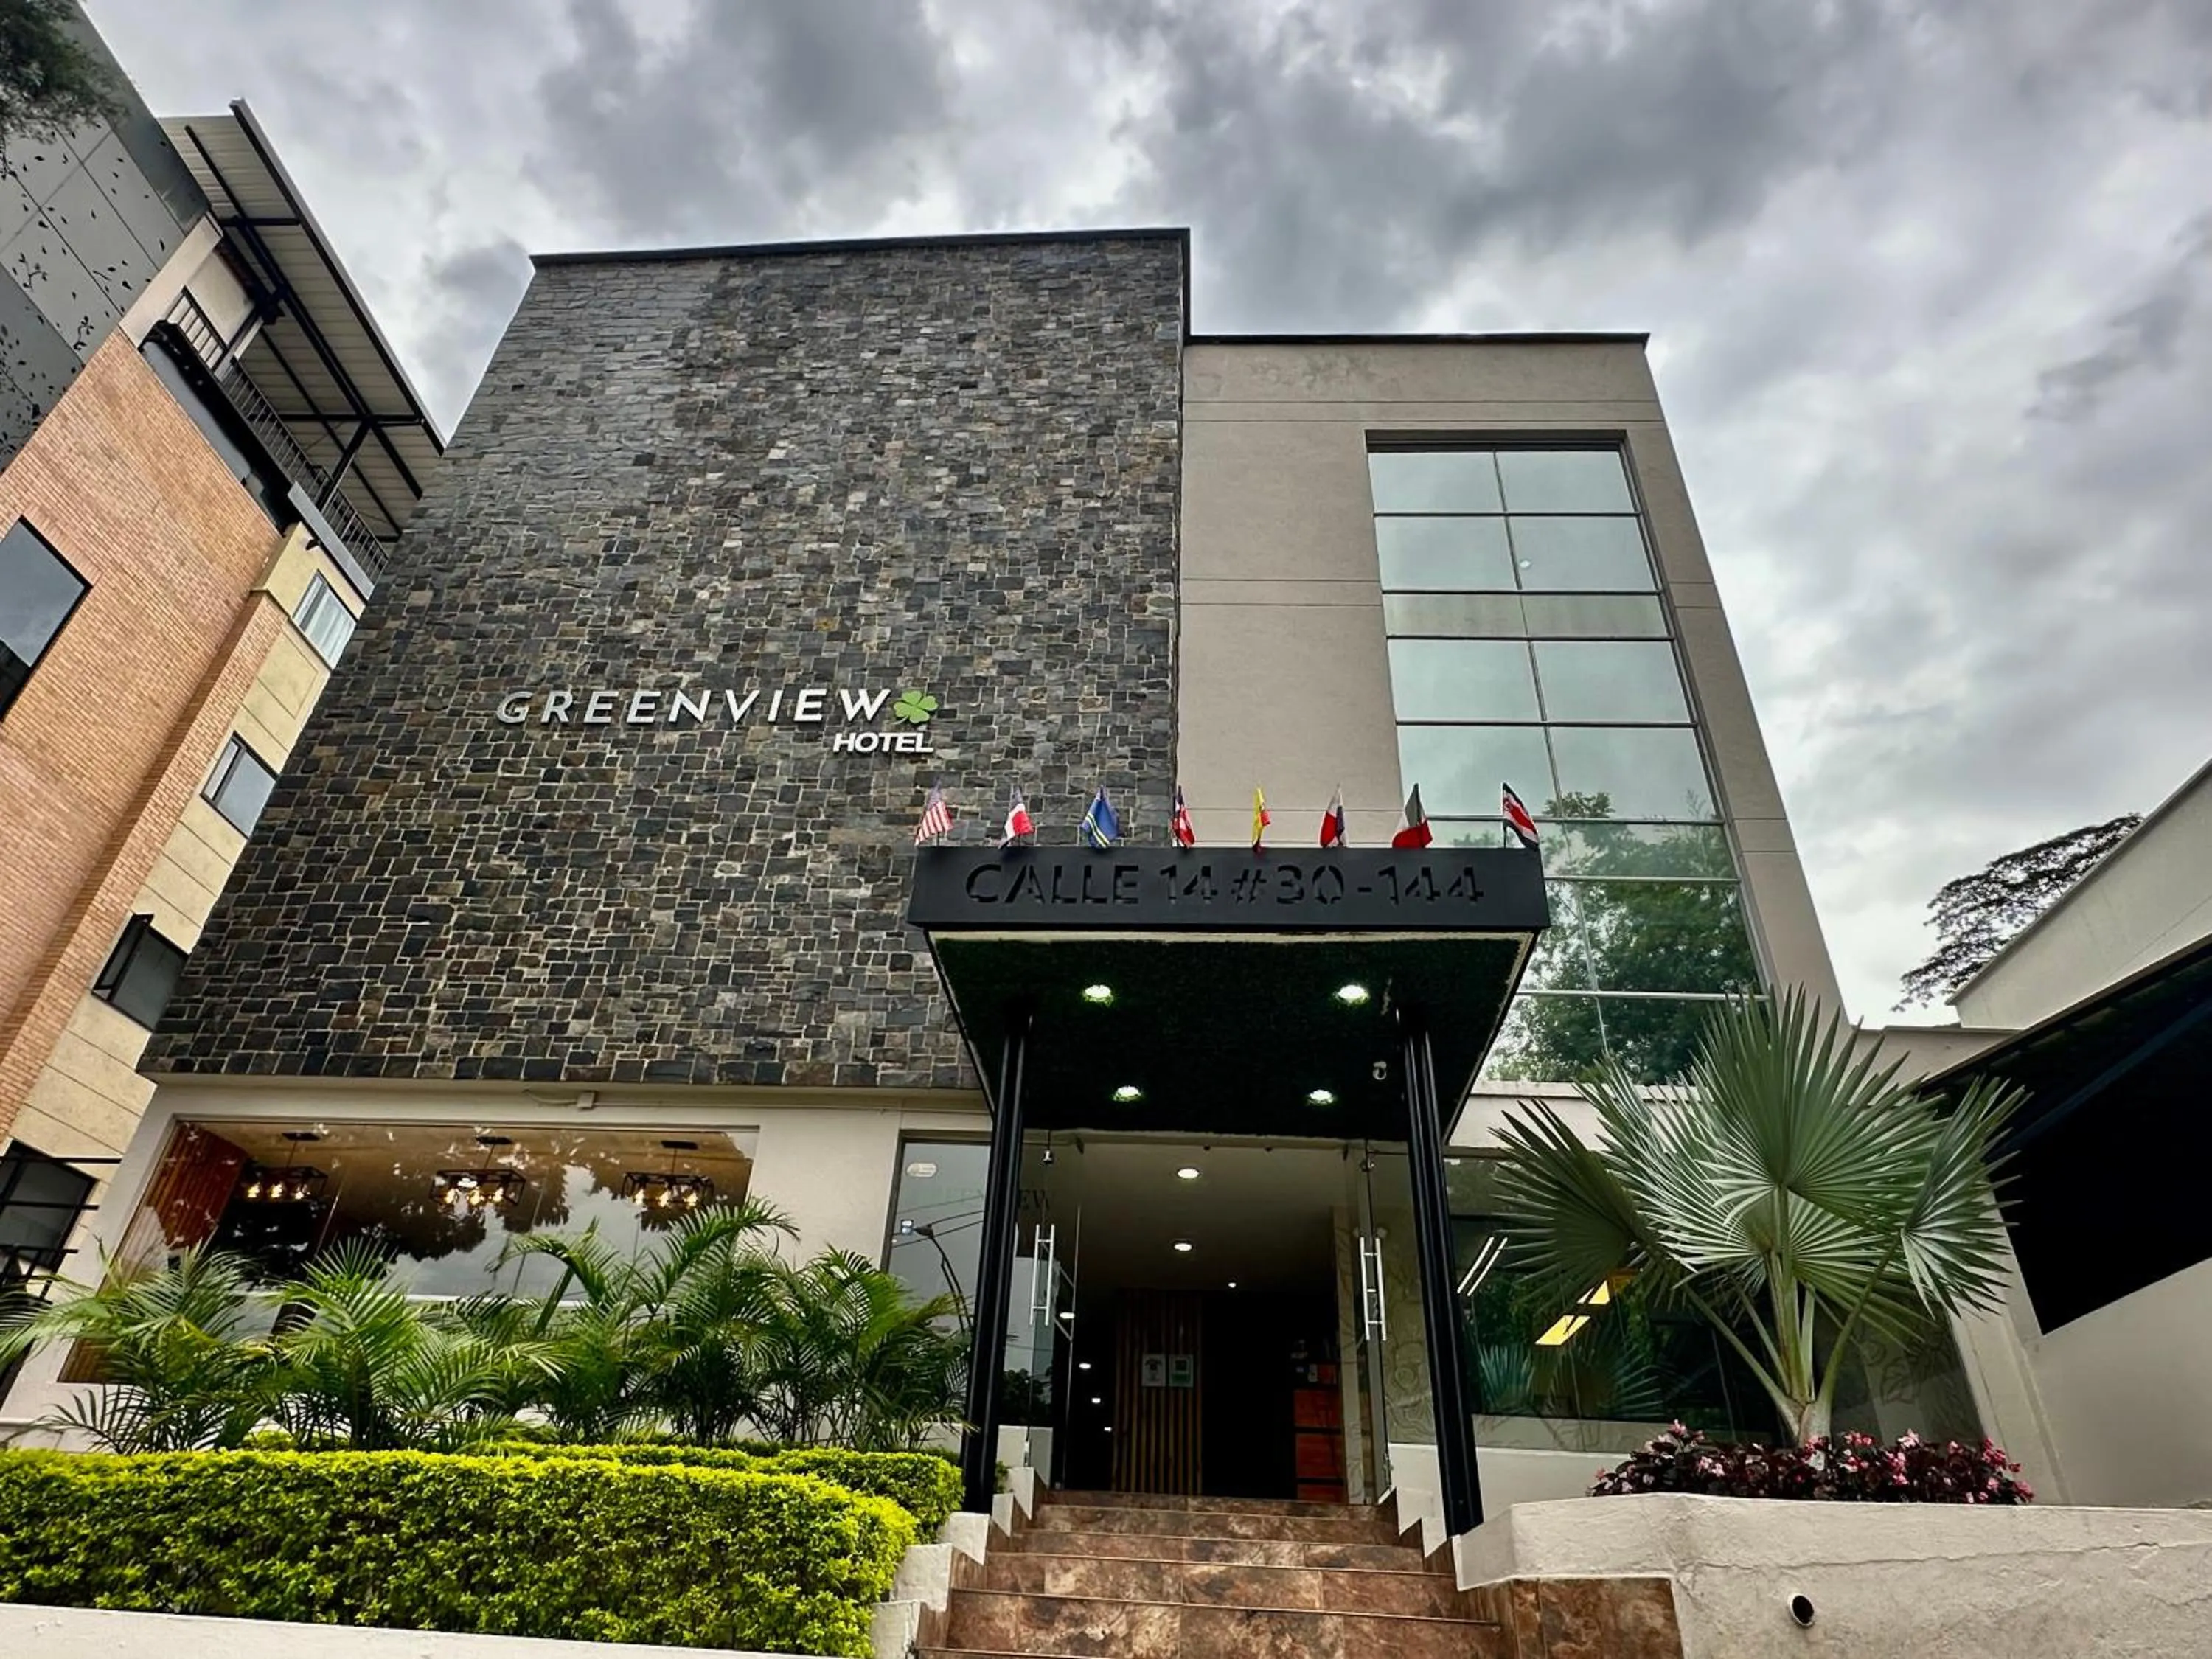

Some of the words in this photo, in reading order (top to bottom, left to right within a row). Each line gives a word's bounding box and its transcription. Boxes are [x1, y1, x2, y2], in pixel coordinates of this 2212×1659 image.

[495, 689, 891, 723] GREENVIEW
[832, 732, 934, 752] HOTEL
[965, 863, 1139, 904] CALLE
[1159, 864, 1218, 905] 14
